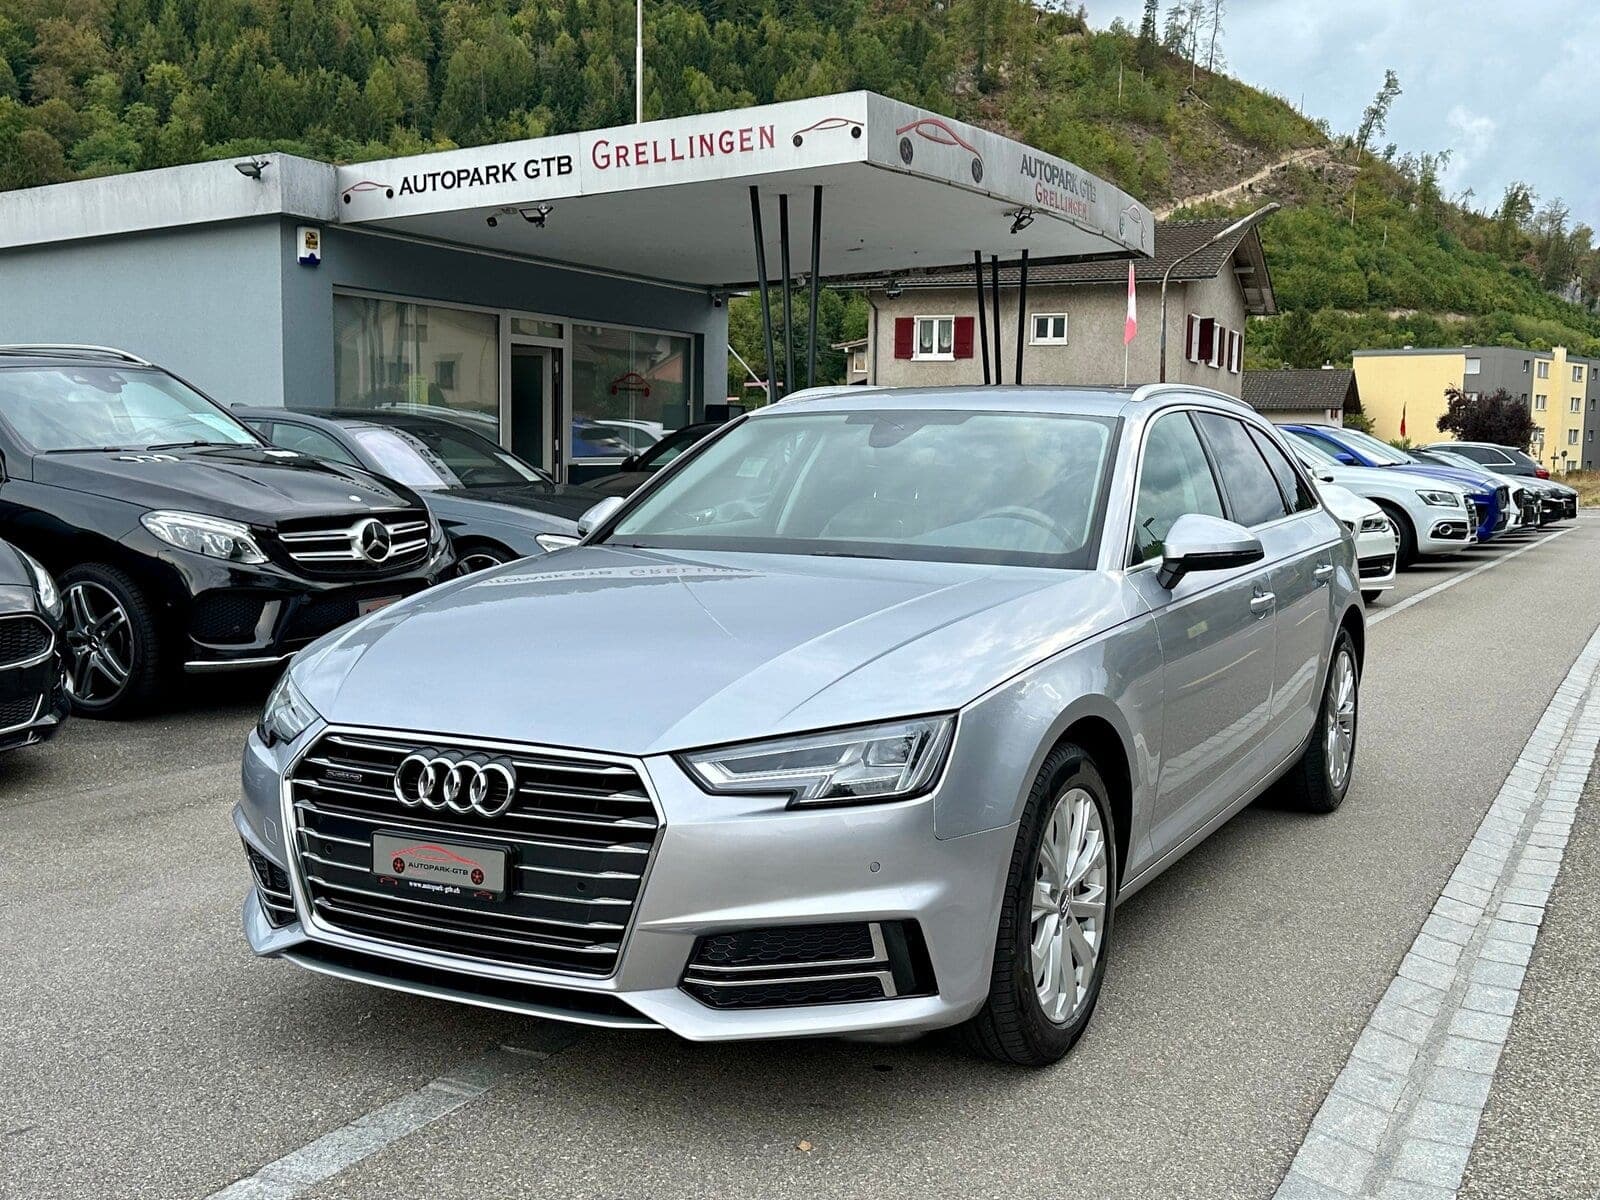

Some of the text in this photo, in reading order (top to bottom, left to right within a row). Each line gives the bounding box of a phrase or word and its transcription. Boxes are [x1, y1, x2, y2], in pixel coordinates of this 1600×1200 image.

[399, 124, 776, 196] AUTOPARK GTB GRELLINGEN
[1020, 153, 1097, 203] AUTOPARK GTB
[408, 862, 468, 876] AUTOPARK-GTB
